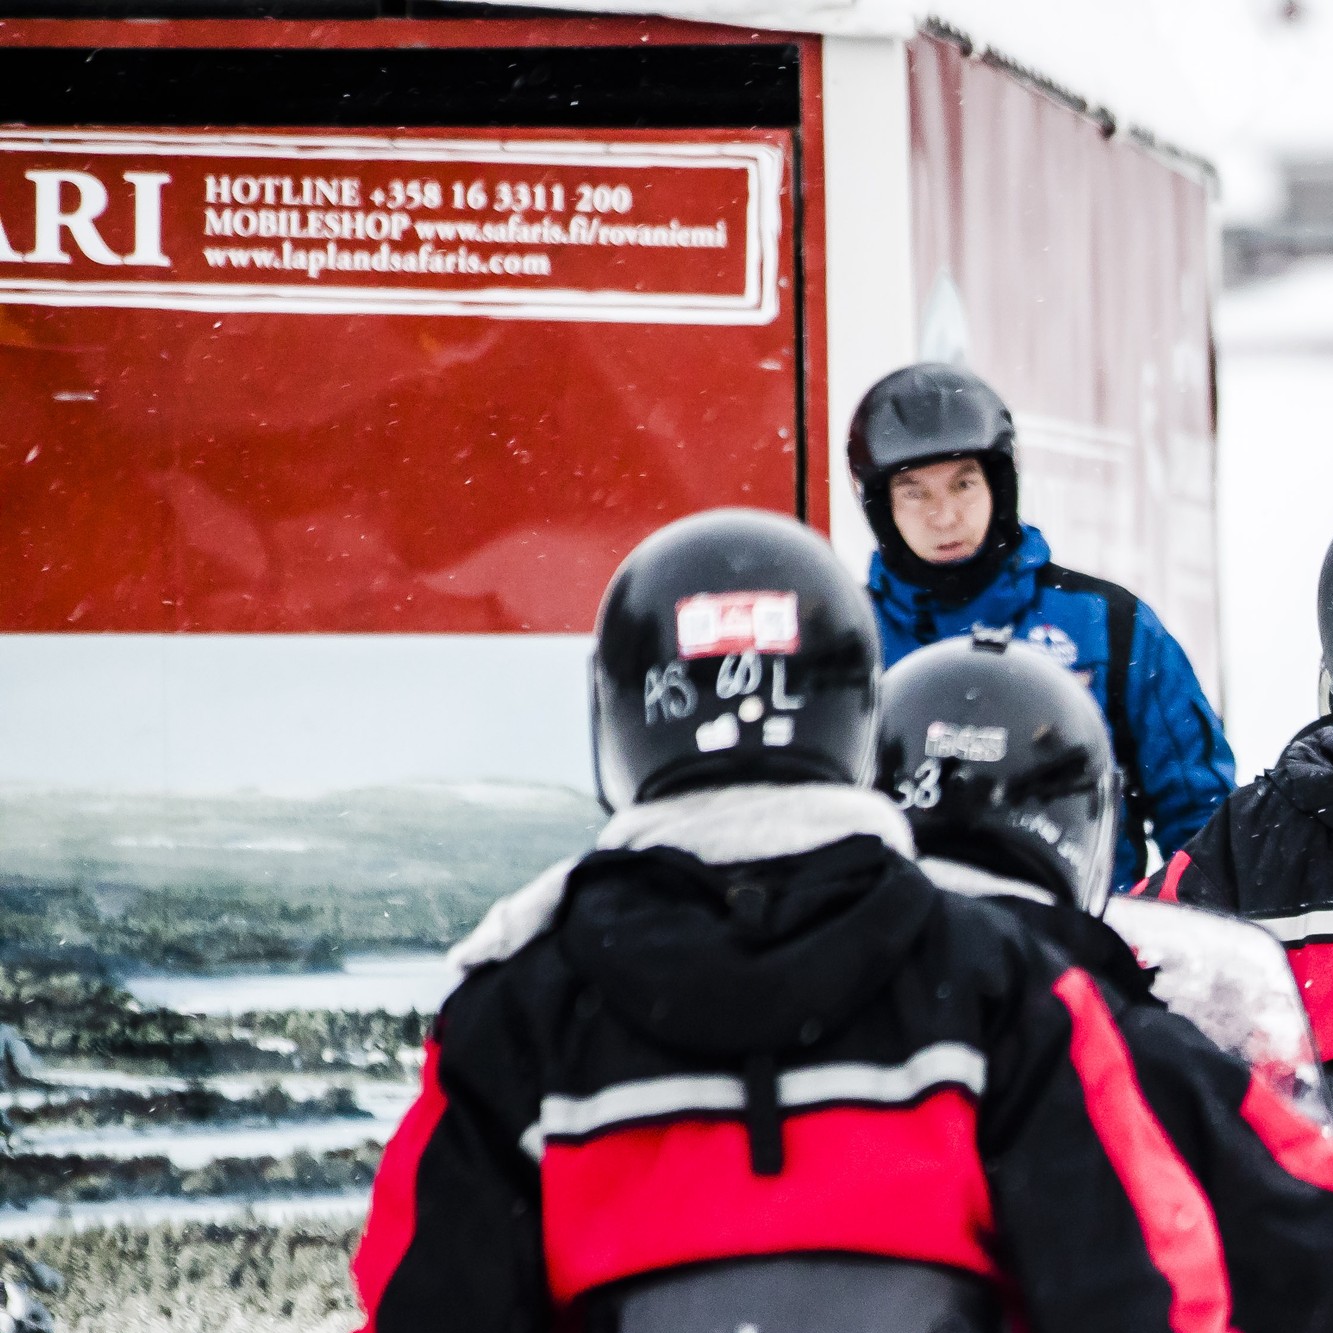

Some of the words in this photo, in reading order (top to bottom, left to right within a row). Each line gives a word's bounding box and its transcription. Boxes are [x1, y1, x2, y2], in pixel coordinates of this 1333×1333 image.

[204, 173, 361, 206] HOTLINE
[369, 178, 442, 210] +358
[452, 180, 487, 210] 16
[494, 181, 564, 213] 3311
[575, 183, 633, 213] 200
[0, 168, 172, 267] RI
[204, 206, 412, 240] MOBILESHOP
[413, 214, 727, 247] www.safaris.fi/rovaniemi
[203, 239, 551, 279] www.laplandsafaris.com
[644, 659, 698, 727] AS
